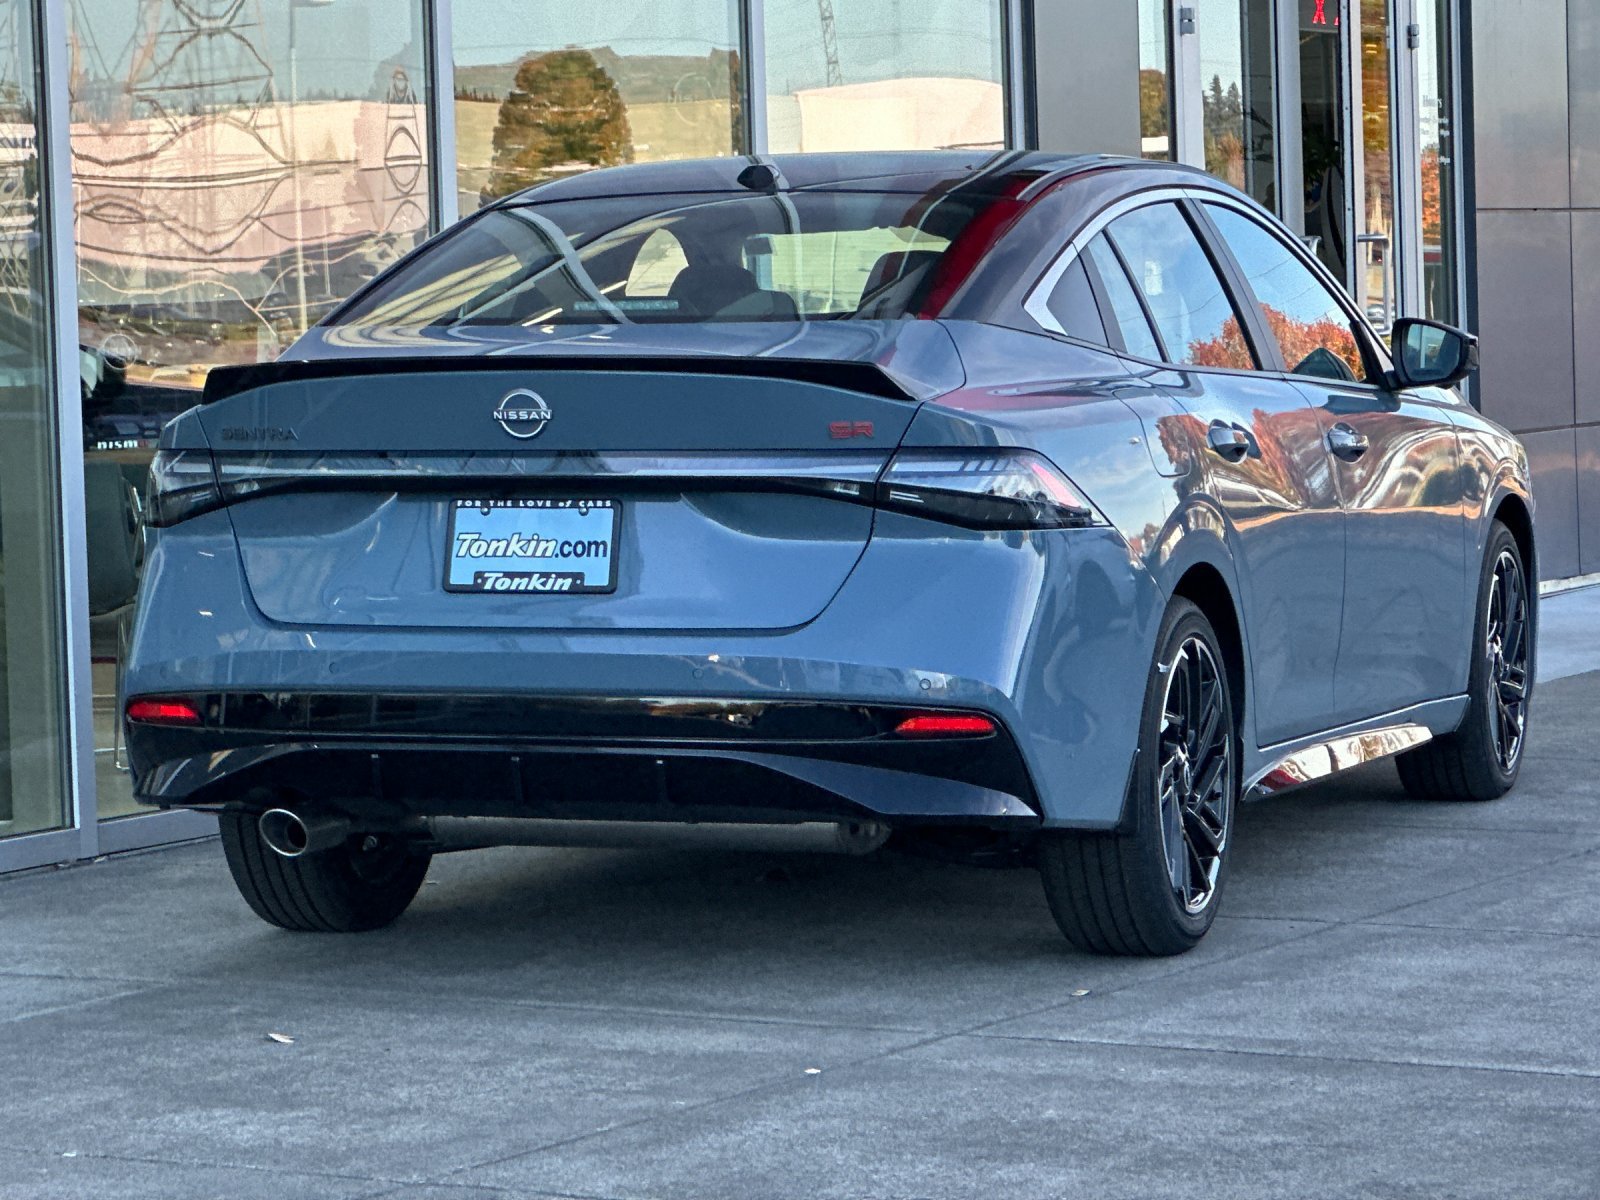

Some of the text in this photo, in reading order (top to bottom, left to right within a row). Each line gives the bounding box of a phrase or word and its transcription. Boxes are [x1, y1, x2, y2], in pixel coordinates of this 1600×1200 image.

[493, 411, 551, 420] NISSAN
[829, 421, 873, 439] SR
[456, 532, 608, 558] Tonkin.com
[483, 572, 572, 591] Tonkin
